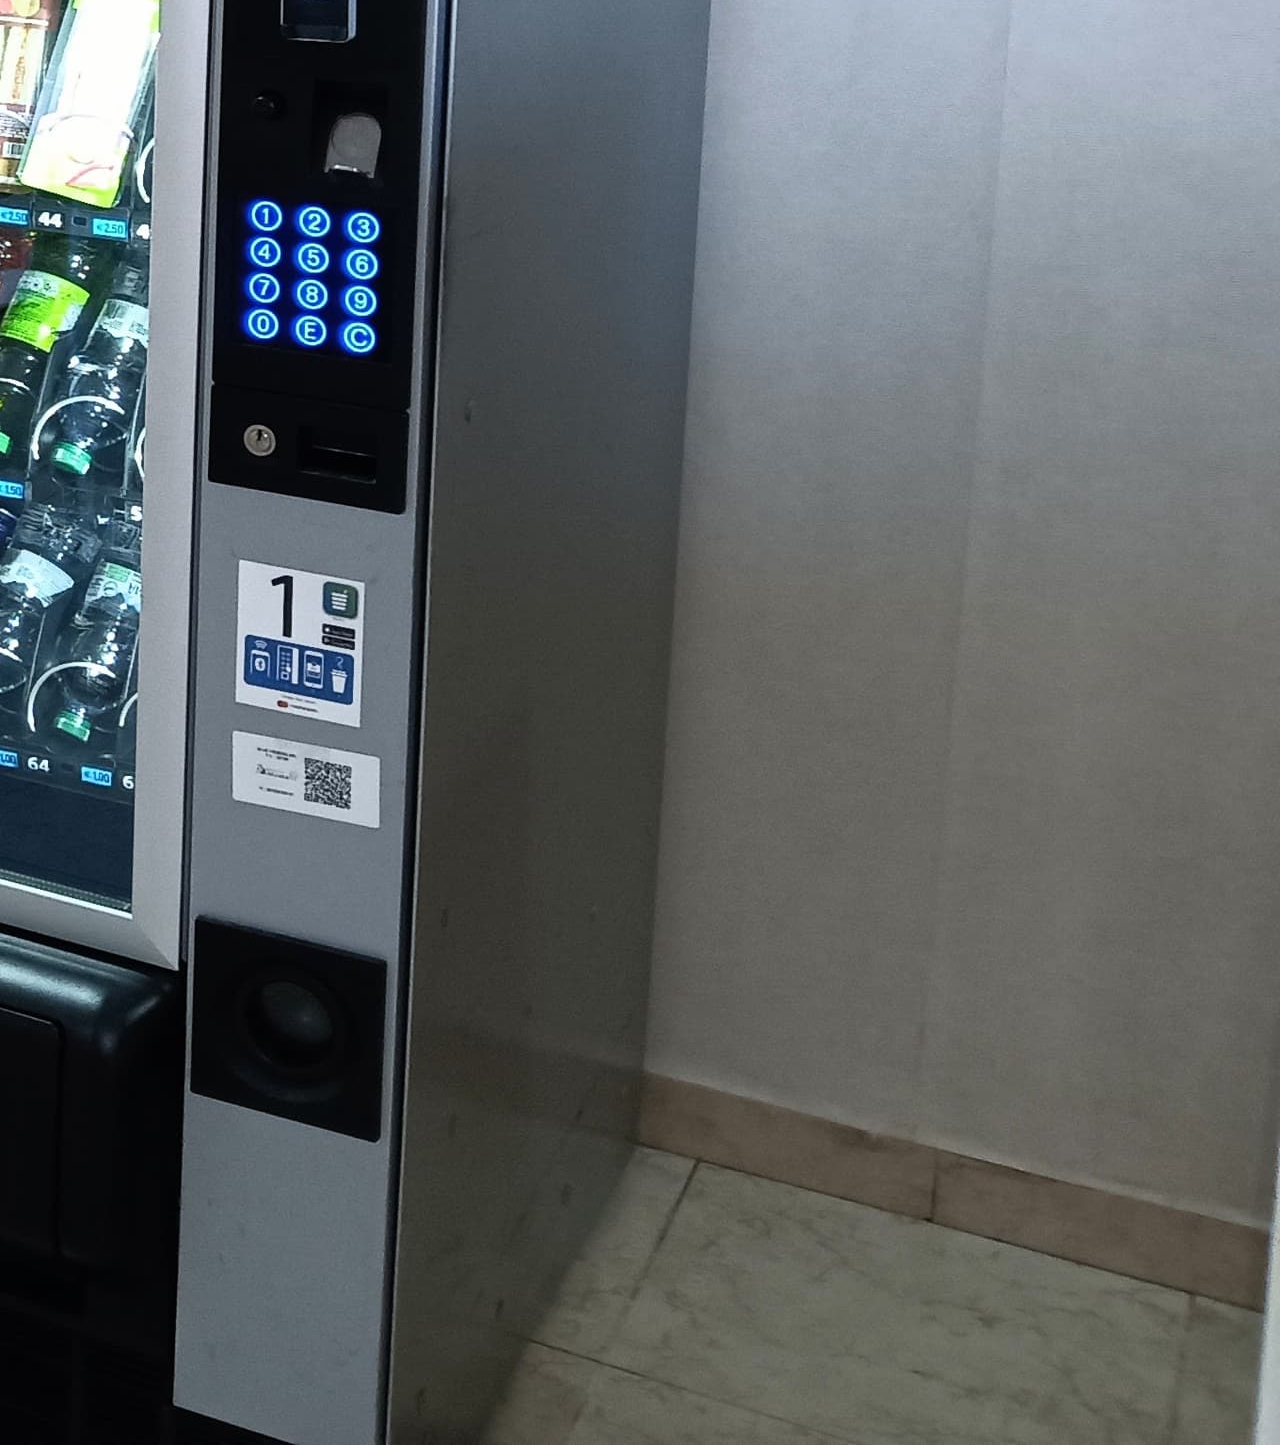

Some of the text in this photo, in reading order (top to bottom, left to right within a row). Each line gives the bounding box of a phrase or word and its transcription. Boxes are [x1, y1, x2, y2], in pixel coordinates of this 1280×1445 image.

[38, 211, 63, 228] 44
[262, 208, 370, 236] 1 2 3
[258, 244, 368, 273] 4 5 6
[258, 280, 367, 310] 7 8 9
[305, 323, 317, 339] E
[353, 329, 366, 346] C
[271, 574, 294, 639] 1
[27, 756, 50, 773] 64
